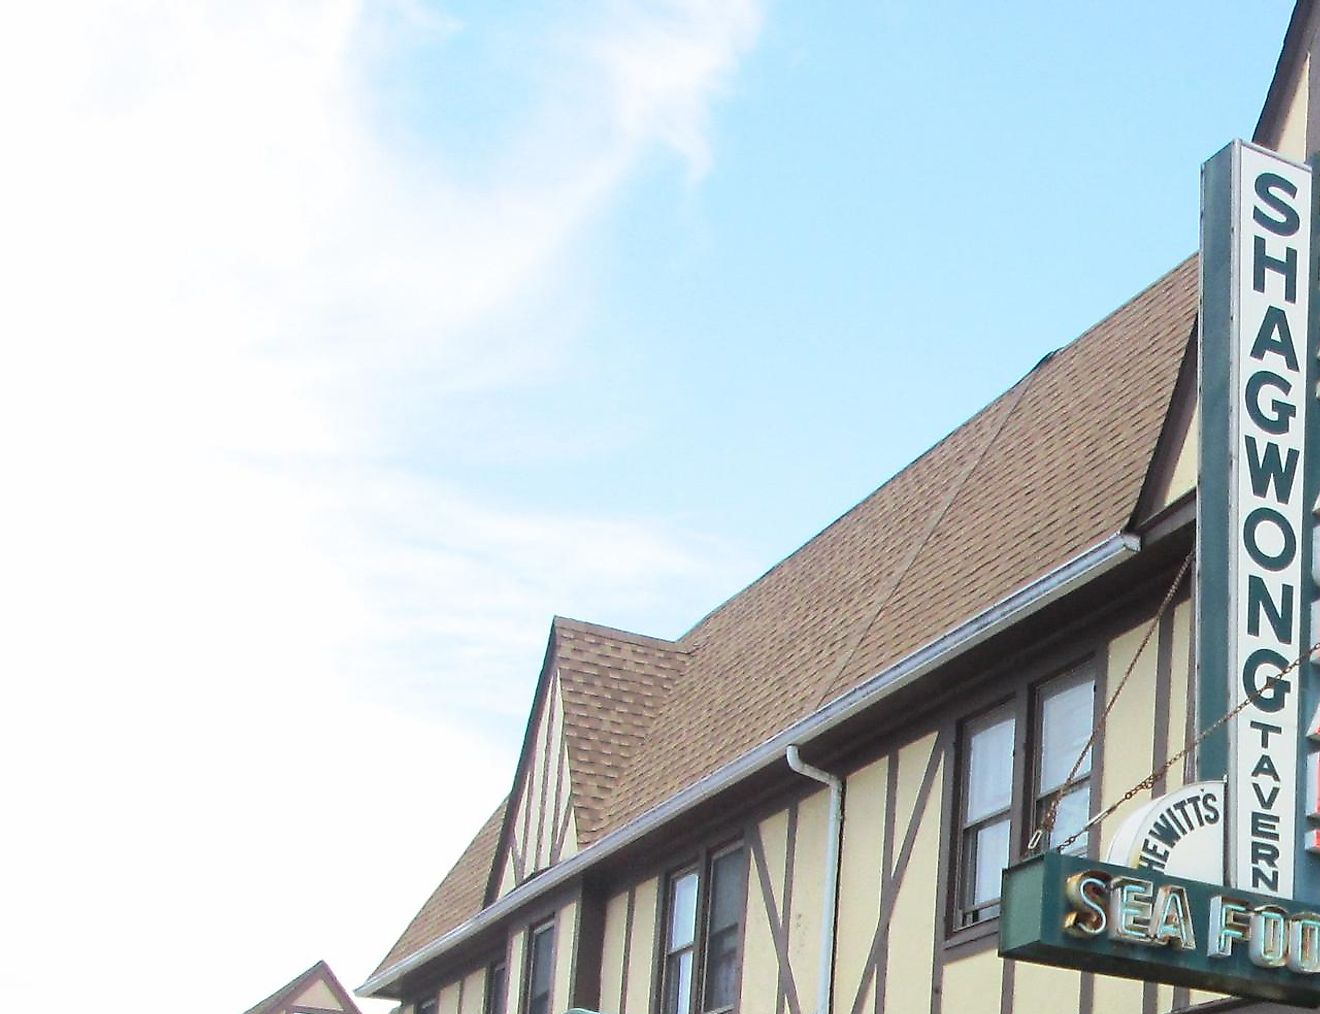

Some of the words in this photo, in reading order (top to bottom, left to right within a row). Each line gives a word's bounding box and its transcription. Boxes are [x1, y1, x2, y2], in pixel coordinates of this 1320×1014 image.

[1242, 171, 1300, 713] SHAGWONG
[1138, 788, 1220, 870] HEWITT'S
[1250, 721, 1282, 892] TAVERN
[1064, 870, 1196, 951] SEA
